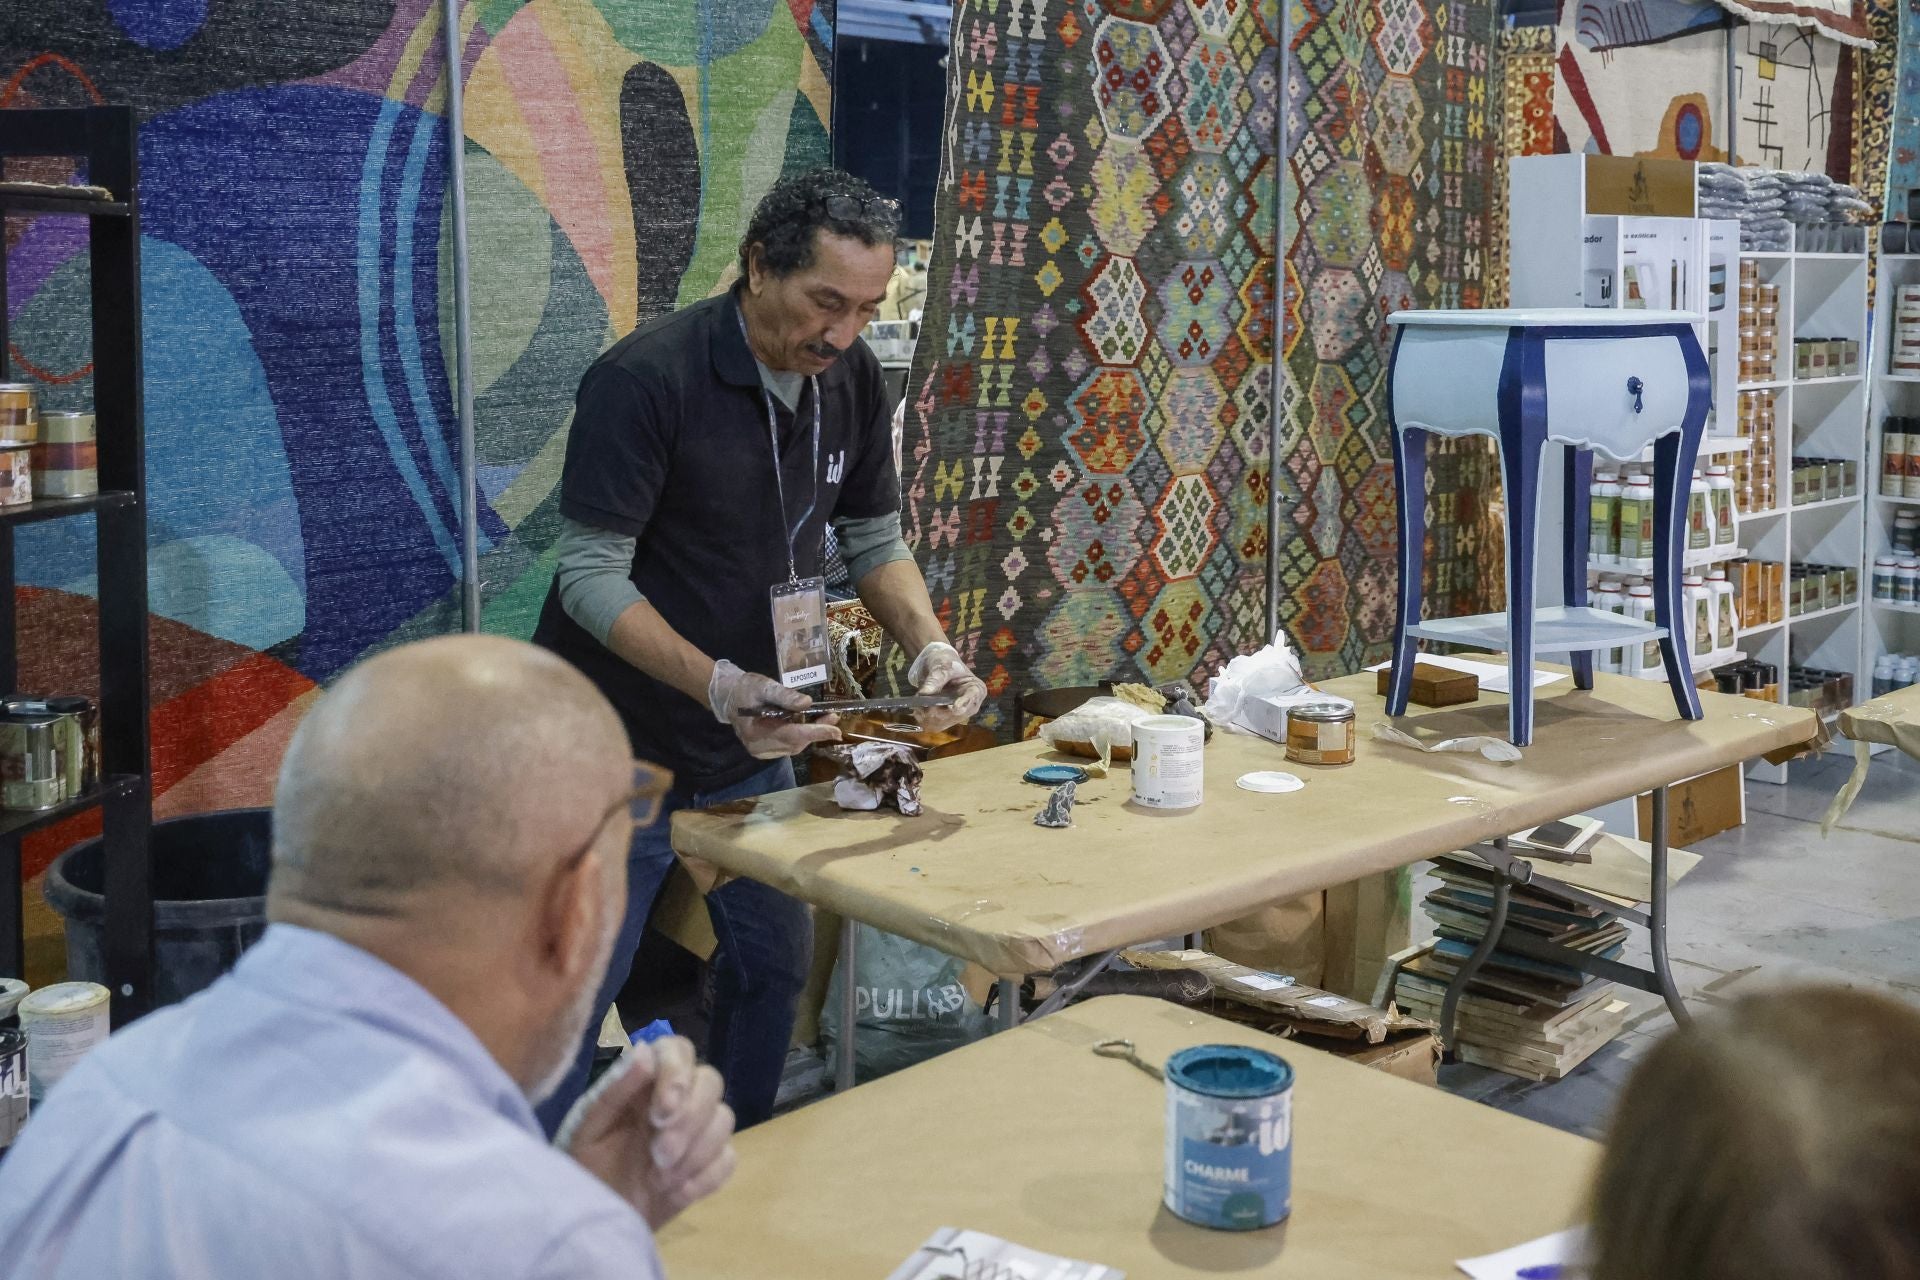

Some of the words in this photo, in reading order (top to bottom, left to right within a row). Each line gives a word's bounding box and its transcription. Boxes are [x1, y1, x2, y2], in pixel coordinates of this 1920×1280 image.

[1601, 275, 1612, 299] id
[826, 450, 844, 483] id
[790, 671, 817, 683] EXPOSITOR
[1259, 1093, 1291, 1156] id
[1184, 1159, 1249, 1182] CHARME
